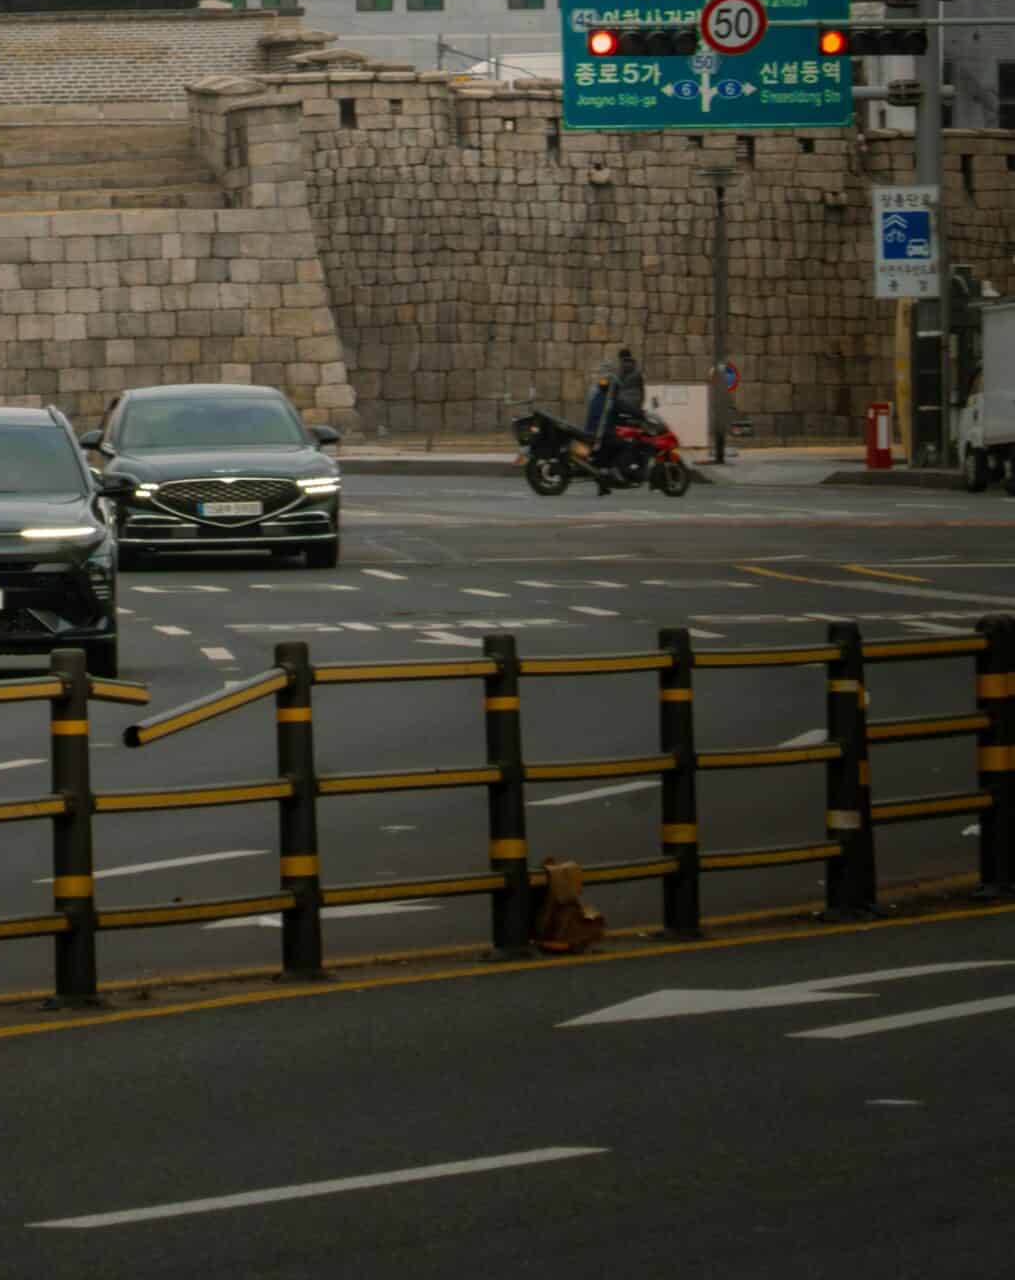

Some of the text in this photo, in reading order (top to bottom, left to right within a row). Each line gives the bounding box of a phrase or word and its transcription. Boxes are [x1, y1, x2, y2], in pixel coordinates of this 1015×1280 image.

[714, 7, 753, 39] 50
[574, 62, 662, 87] 종로5가
[759, 60, 841, 85] 신설동역
[680, 83, 691, 97] 6
[724, 82, 737, 96] 6
